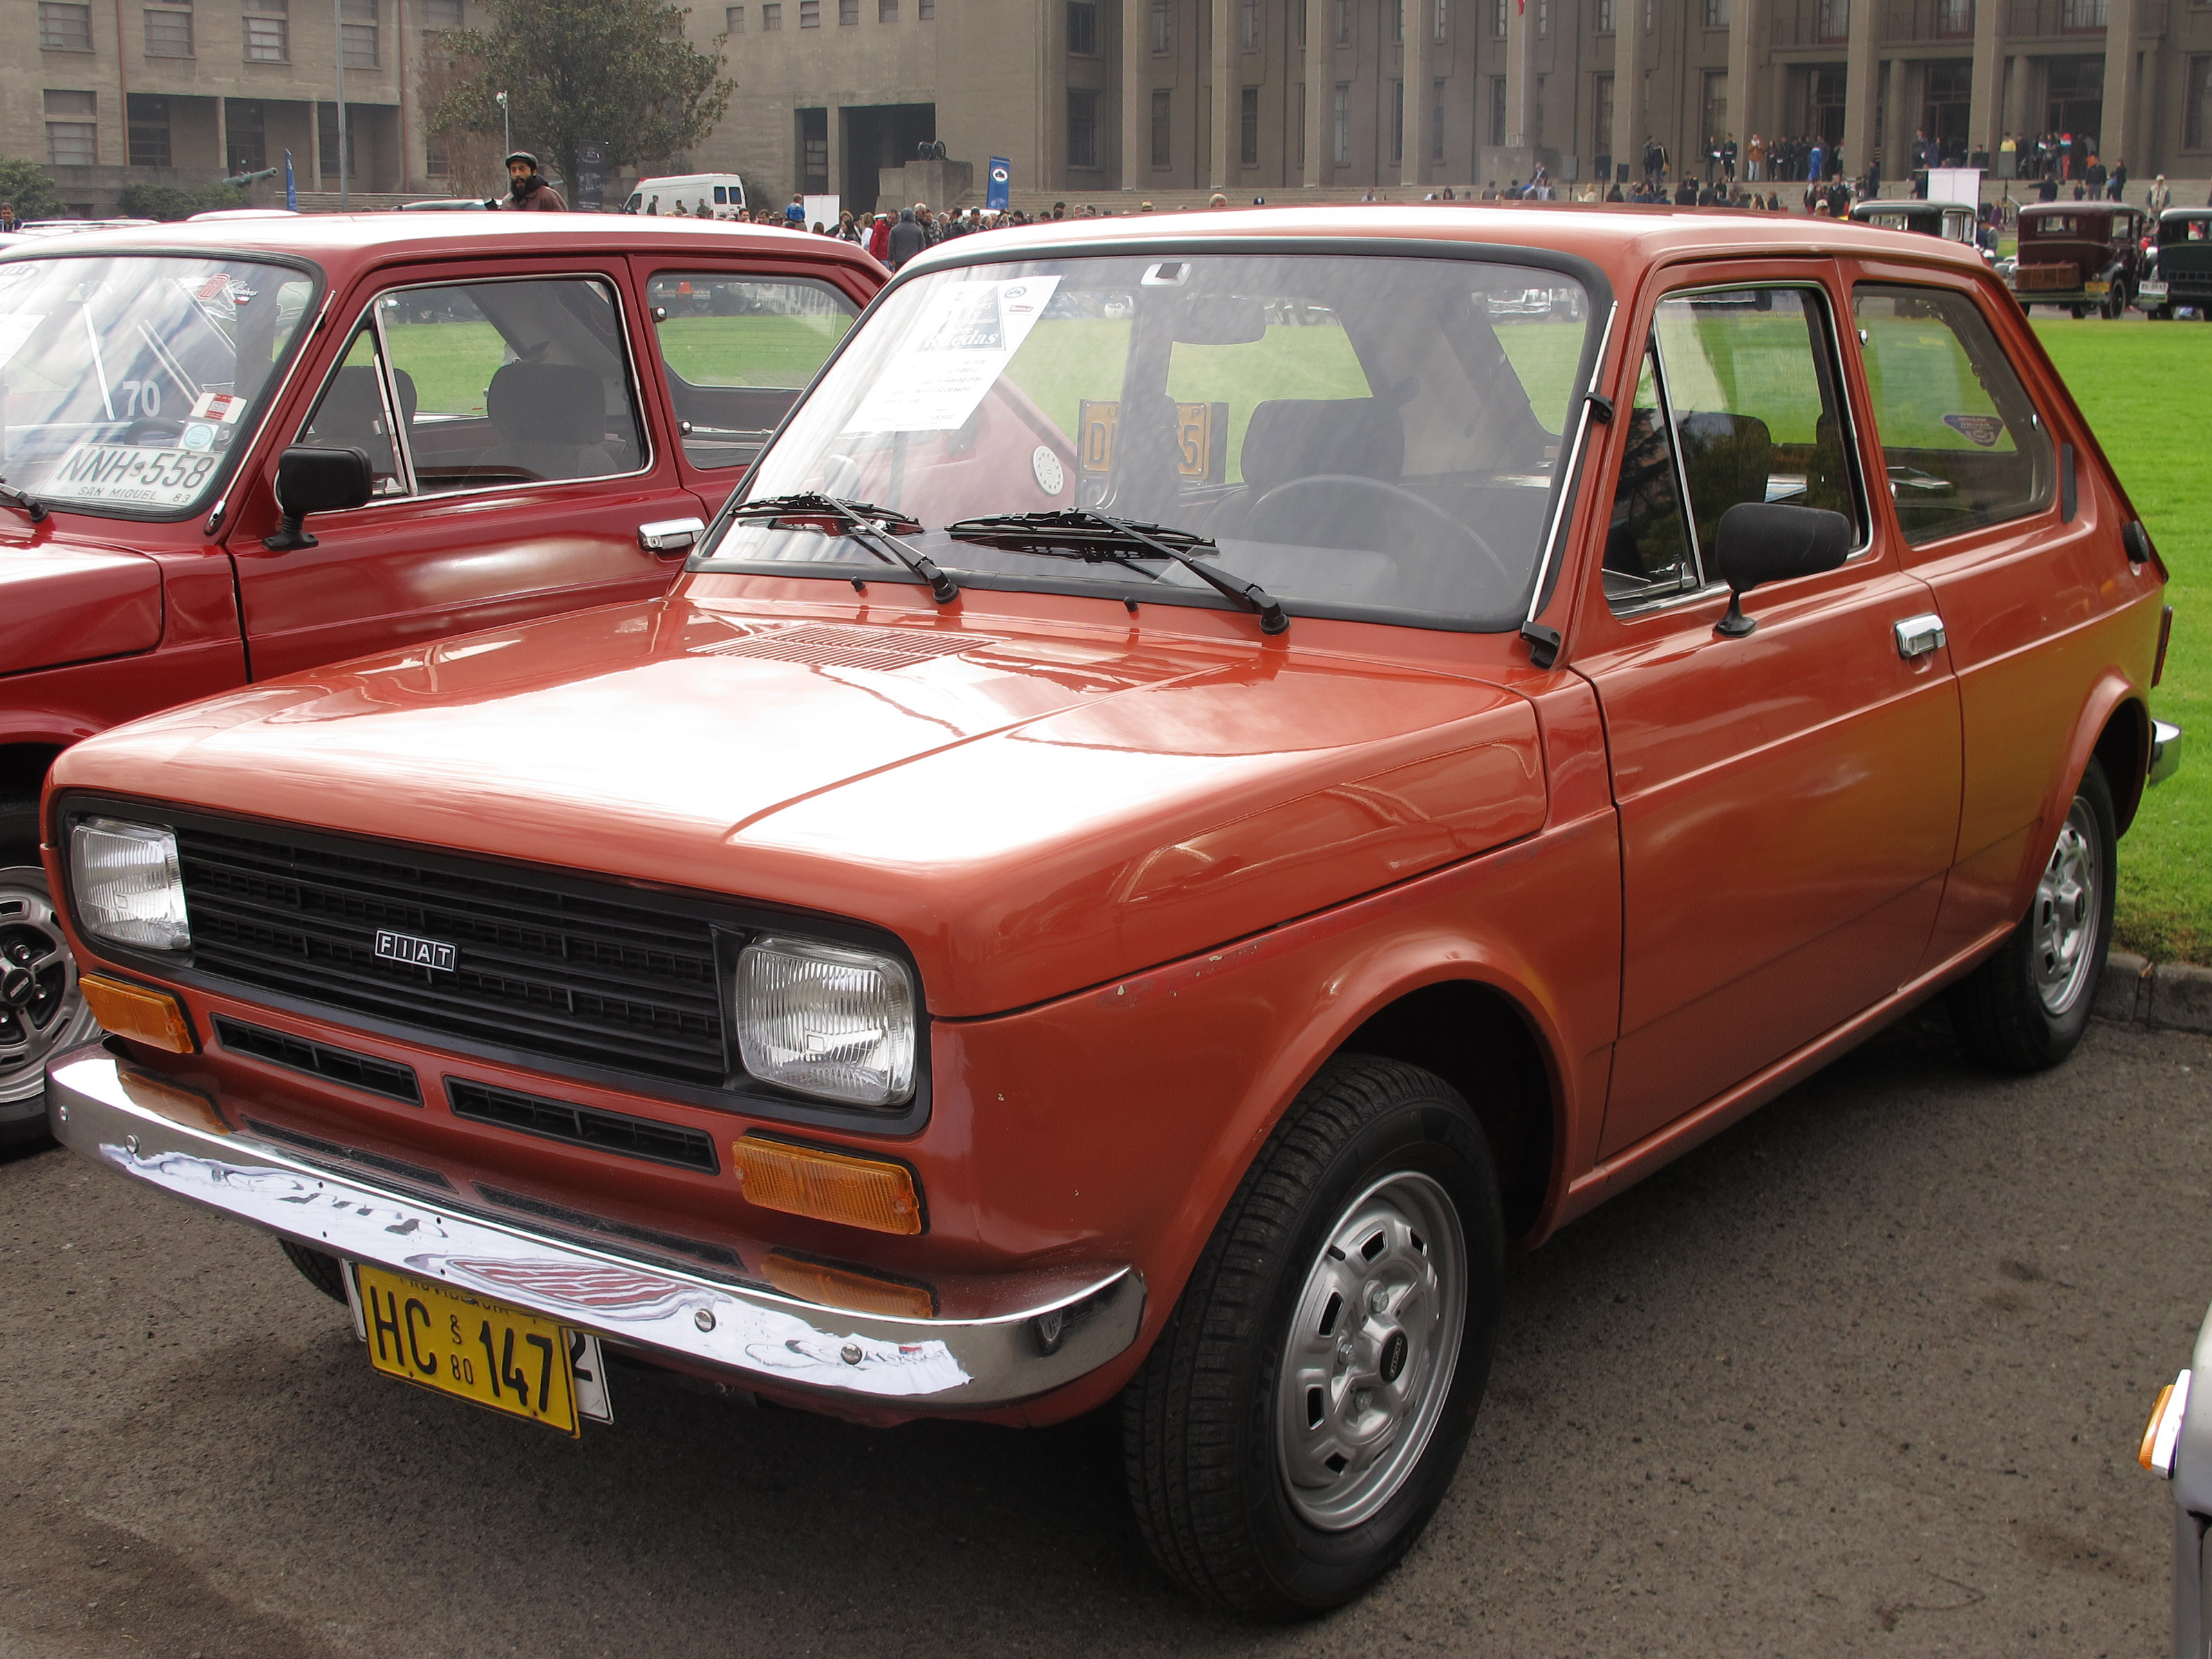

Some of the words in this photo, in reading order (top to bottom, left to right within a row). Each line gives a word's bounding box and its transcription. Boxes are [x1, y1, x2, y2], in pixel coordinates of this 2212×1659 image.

[123, 381, 160, 417] 70
[78, 487, 105, 496] SAN
[108, 489, 158, 500] MIGUEL
[173, 494, 191, 503] 83
[380, 935, 451, 966] FIAT
[371, 1286, 437, 1375] HC
[479, 1320, 553, 1413] 147
[451, 1353, 474, 1385] 80
